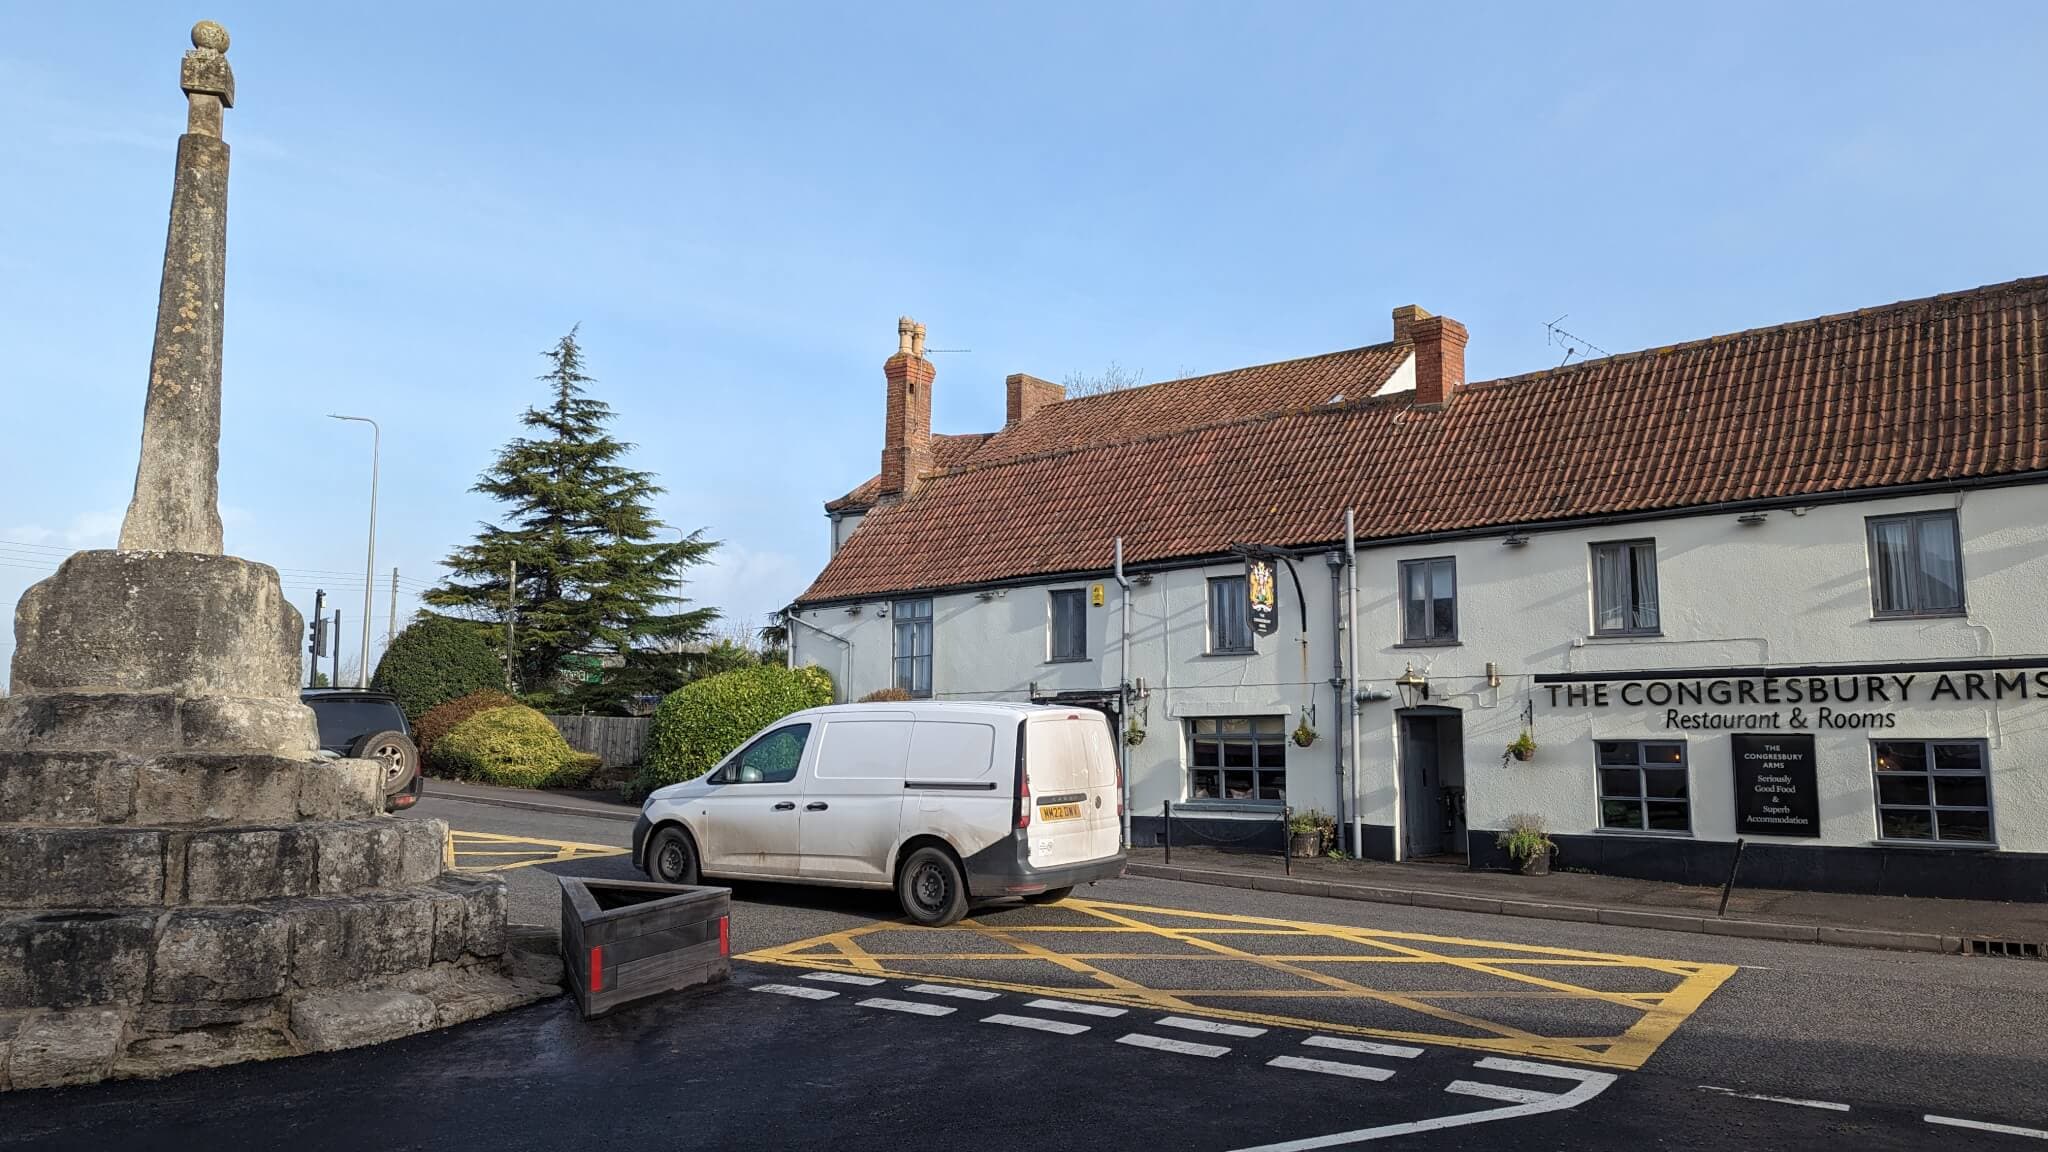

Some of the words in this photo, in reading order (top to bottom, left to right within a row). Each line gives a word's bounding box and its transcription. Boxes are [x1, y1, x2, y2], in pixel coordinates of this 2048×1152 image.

[1544, 683, 1609, 707] THE
[1621, 675, 1916, 706] CONGRESBURY
[1931, 671, 2048, 701] ARMS
[1666, 708, 1780, 729] Restaurant
[1789, 707, 1808, 729] &
[1818, 706, 1896, 729] Rooms
[1757, 774, 1792, 784] Seriously
[1776, 785, 1796, 793] Food
[1772, 795, 1780, 803] &
[1762, 805, 1790, 815] Superb
[1746, 815, 1809, 825] Accommodation
